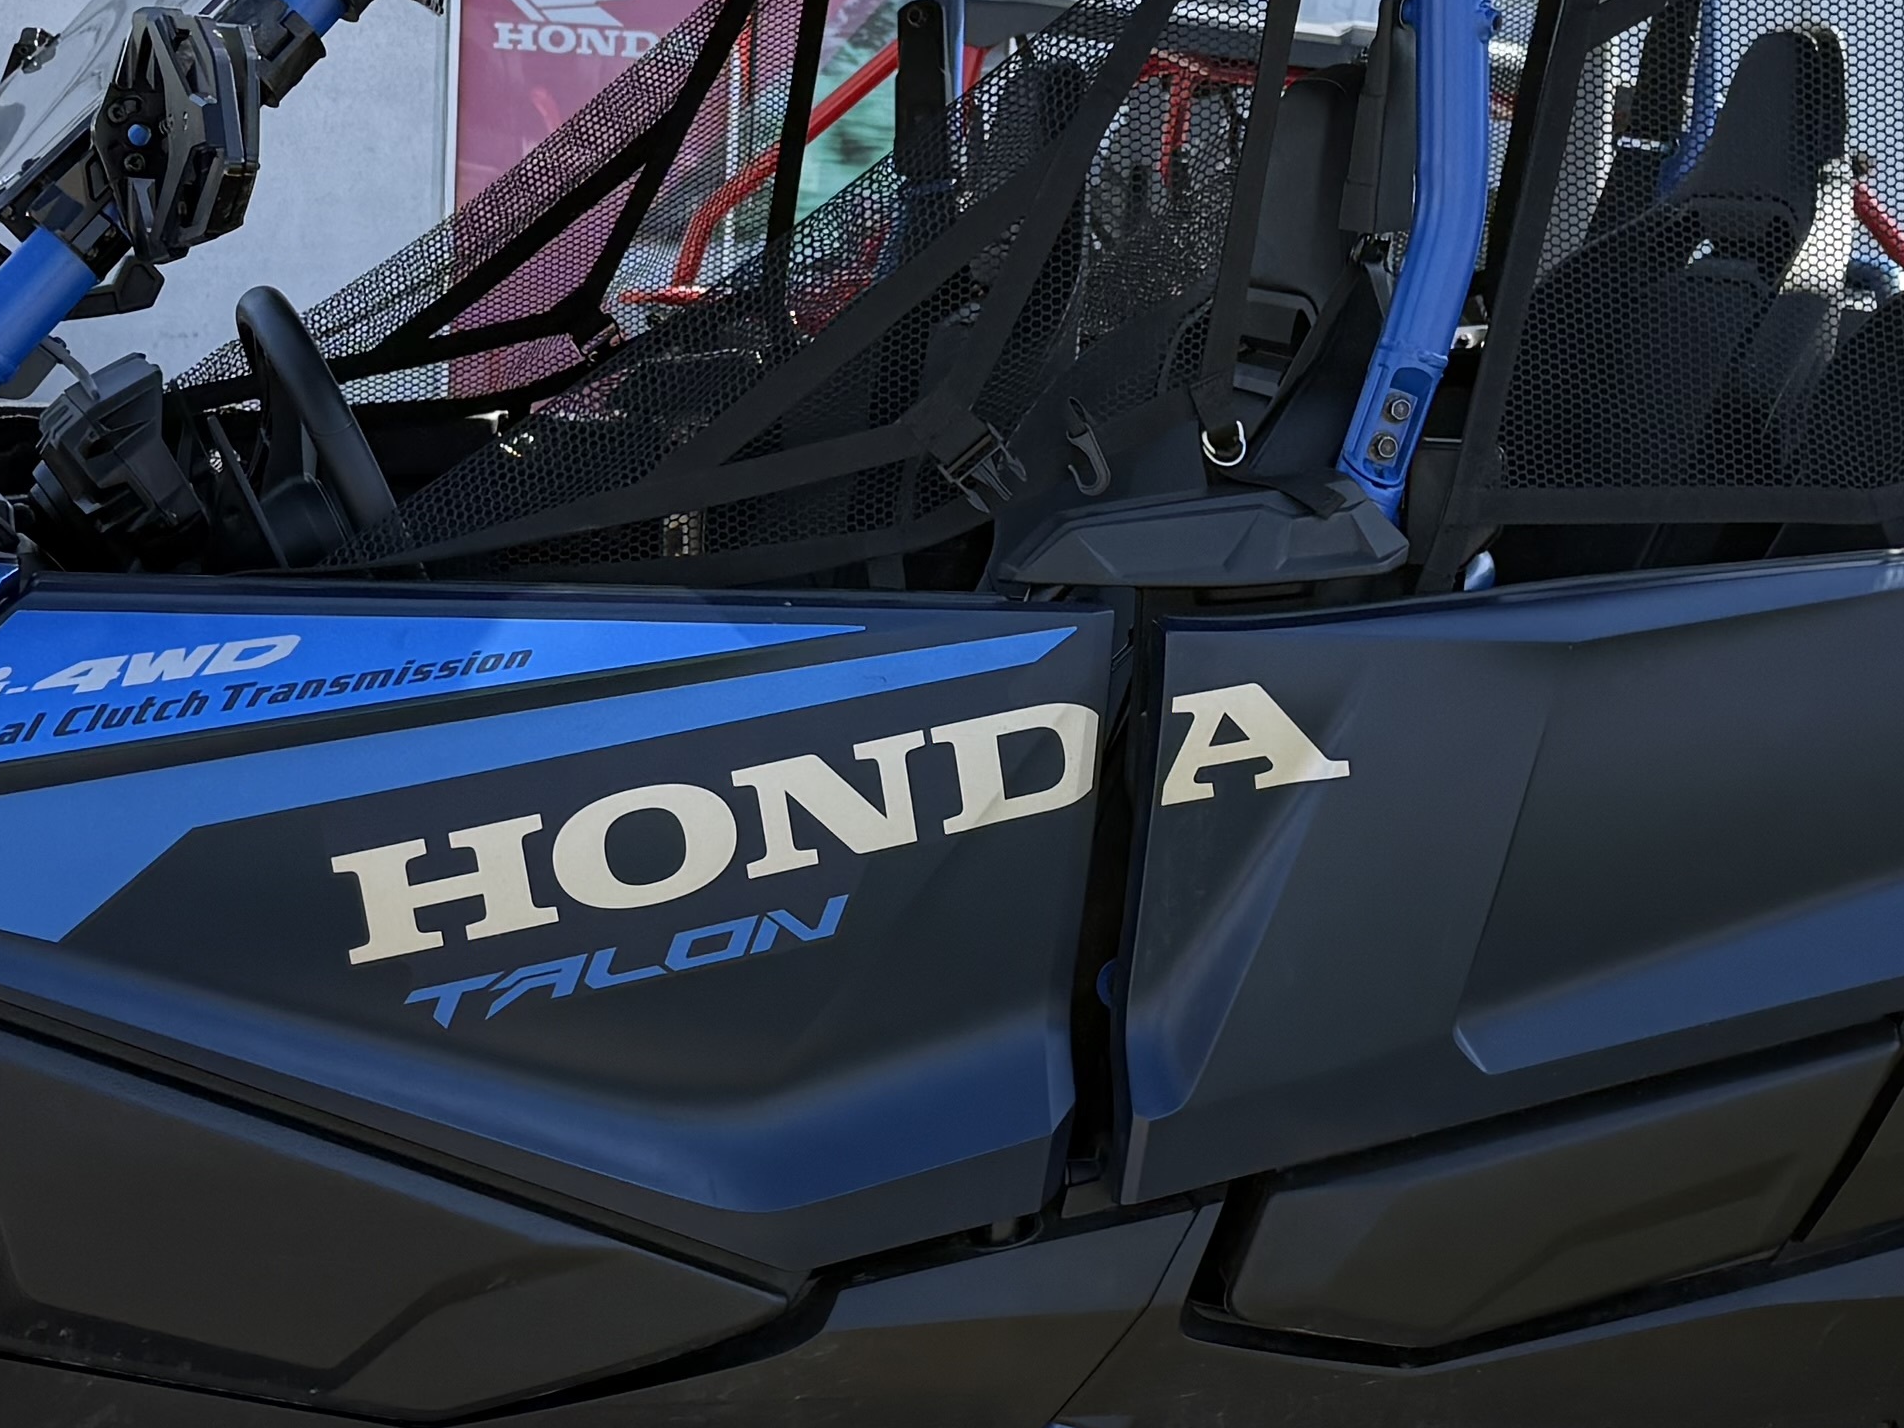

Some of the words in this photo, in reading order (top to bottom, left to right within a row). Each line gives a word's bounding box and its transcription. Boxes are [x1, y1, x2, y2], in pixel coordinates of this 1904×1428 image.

[52, 688, 209, 739] Clutch
[220, 647, 534, 712] Transmission
[331, 682, 1351, 966] HONDA
[403, 893, 849, 1030] TALON
